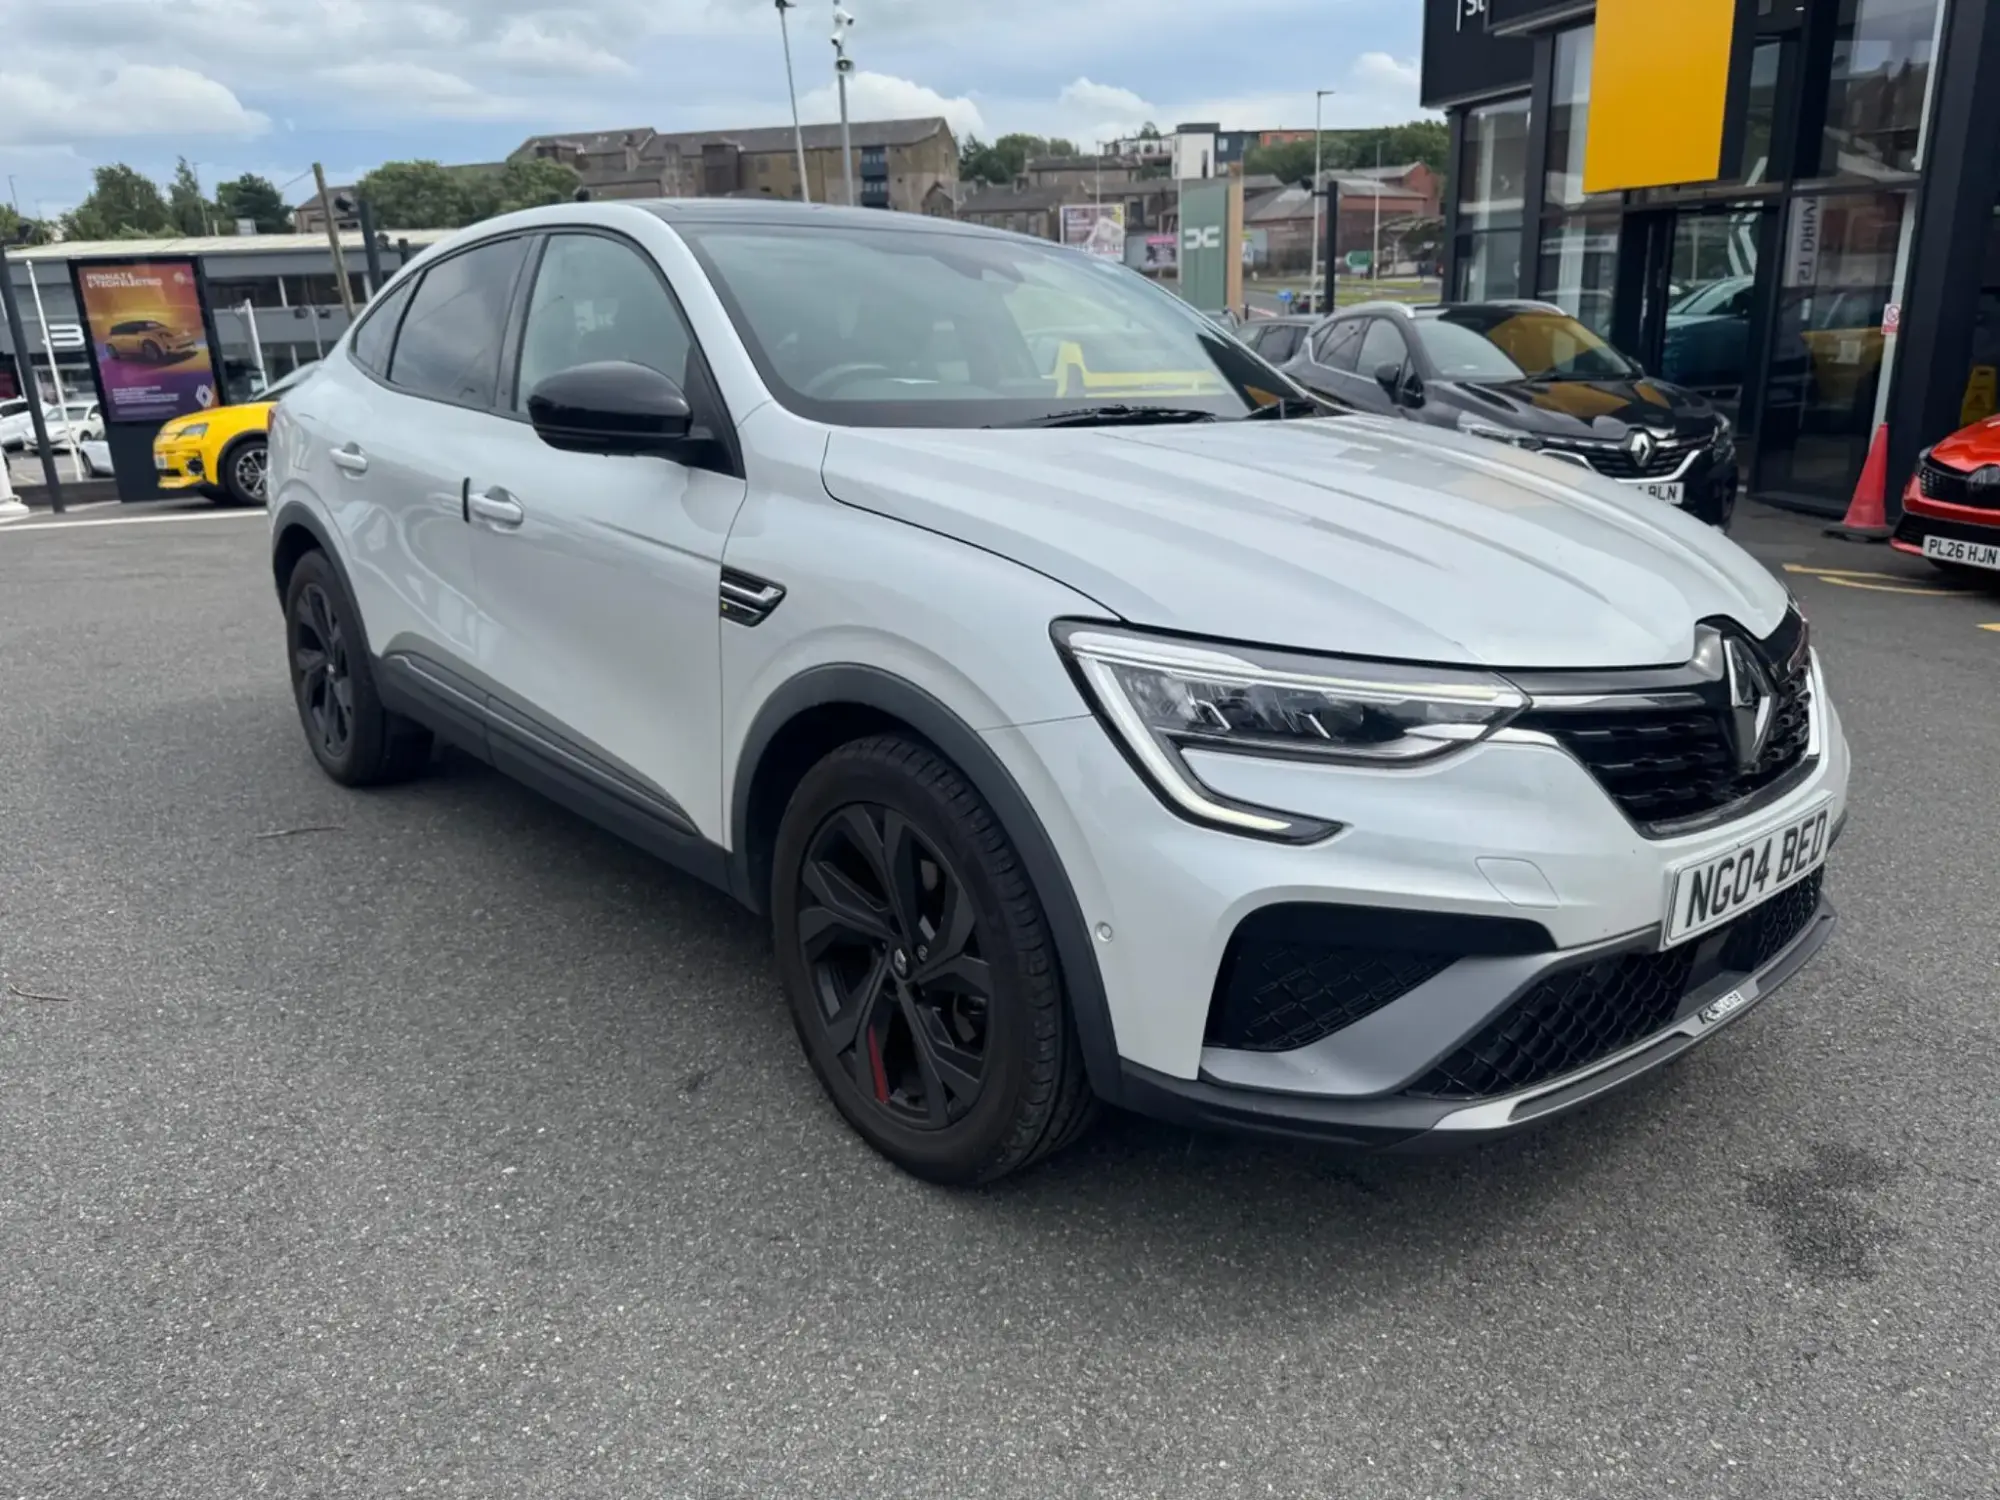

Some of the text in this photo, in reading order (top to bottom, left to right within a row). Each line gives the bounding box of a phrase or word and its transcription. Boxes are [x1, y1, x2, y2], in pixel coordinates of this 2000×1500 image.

[1928, 538, 1998, 564] PL26 HJN
[1685, 838, 1772, 928] NG04
